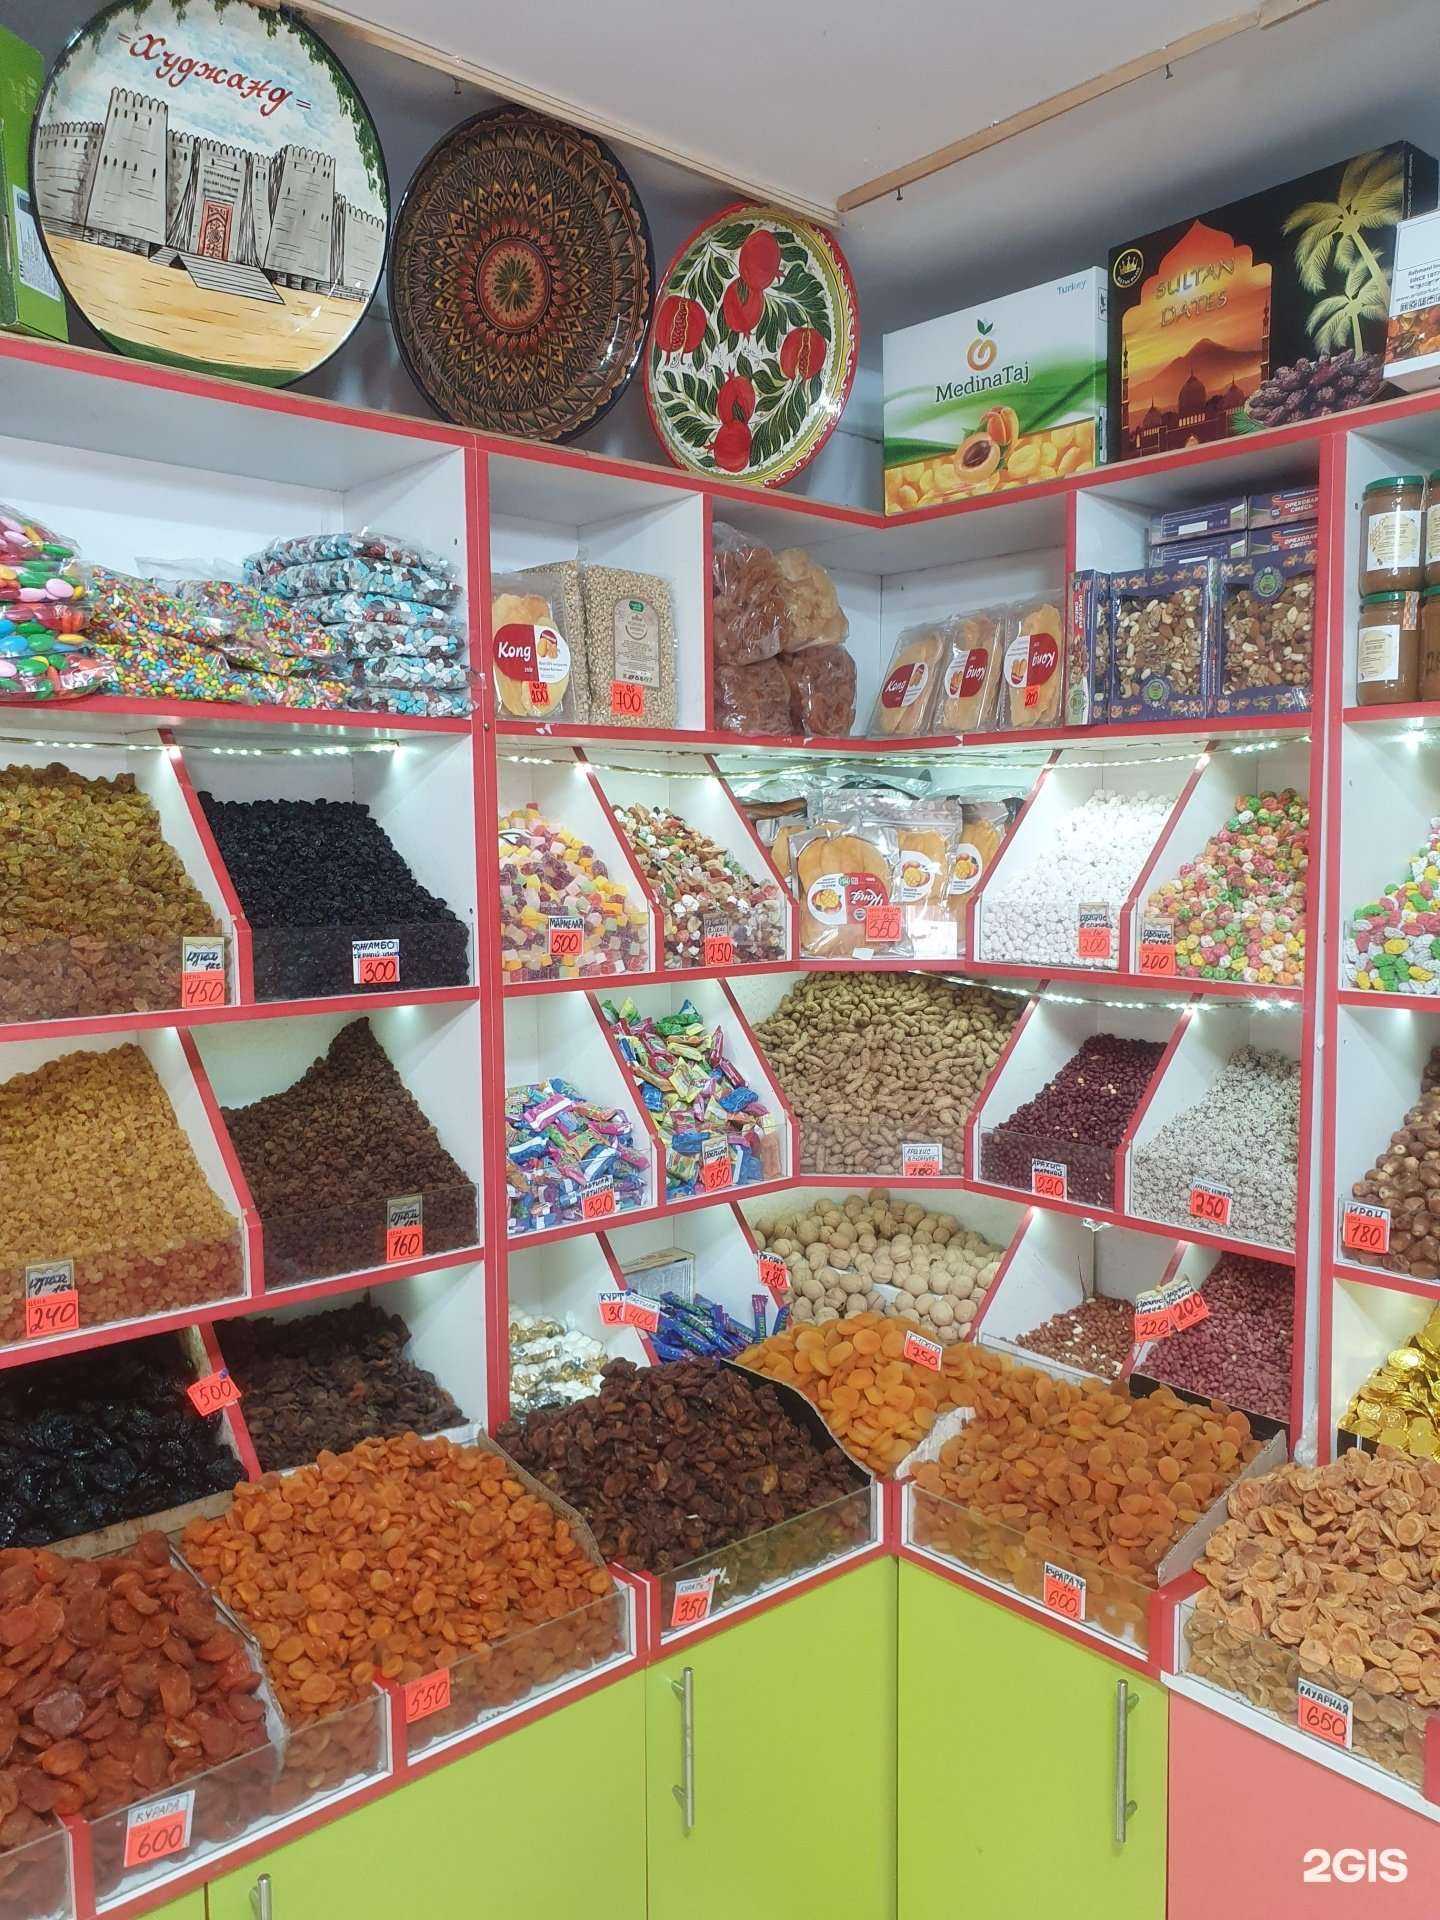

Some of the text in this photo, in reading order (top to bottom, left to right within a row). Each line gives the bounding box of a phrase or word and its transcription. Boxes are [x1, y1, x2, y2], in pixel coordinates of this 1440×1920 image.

[129, 33, 293, 117] Худжанд
[1057, 279, 1087, 296] Turkey
[1156, 257, 1236, 299] SULTAN
[1160, 290, 1228, 328] DATES
[935, 361, 1030, 403] MedinaTaj
[498, 641, 531, 662] Kong
[1032, 651, 1056, 667] Kong
[966, 666, 986, 681] Kong
[886, 680, 907, 693] Kong
[552, 934, 579, 953] 500
[363, 960, 396, 983] 300
[1142, 954, 1170, 970] 200
[186, 980, 224, 1003] 450
[1038, 1176, 1064, 1196] 220
[393, 1233, 420, 1257] 160
[1352, 1224, 1381, 1246] 180
[600, 1292, 625, 1302] КУРТ
[31, 1303, 76, 1331] 240
[1140, 1320, 1169, 1336] 220
[199, 1380, 231, 1406] 500
[678, 1597, 708, 1622] 350
[1048, 1590, 1078, 1613] 600
[409, 1680, 448, 1717] 550
[1306, 1706, 1347, 1737] 650
[137, 1824, 183, 1859] 600
